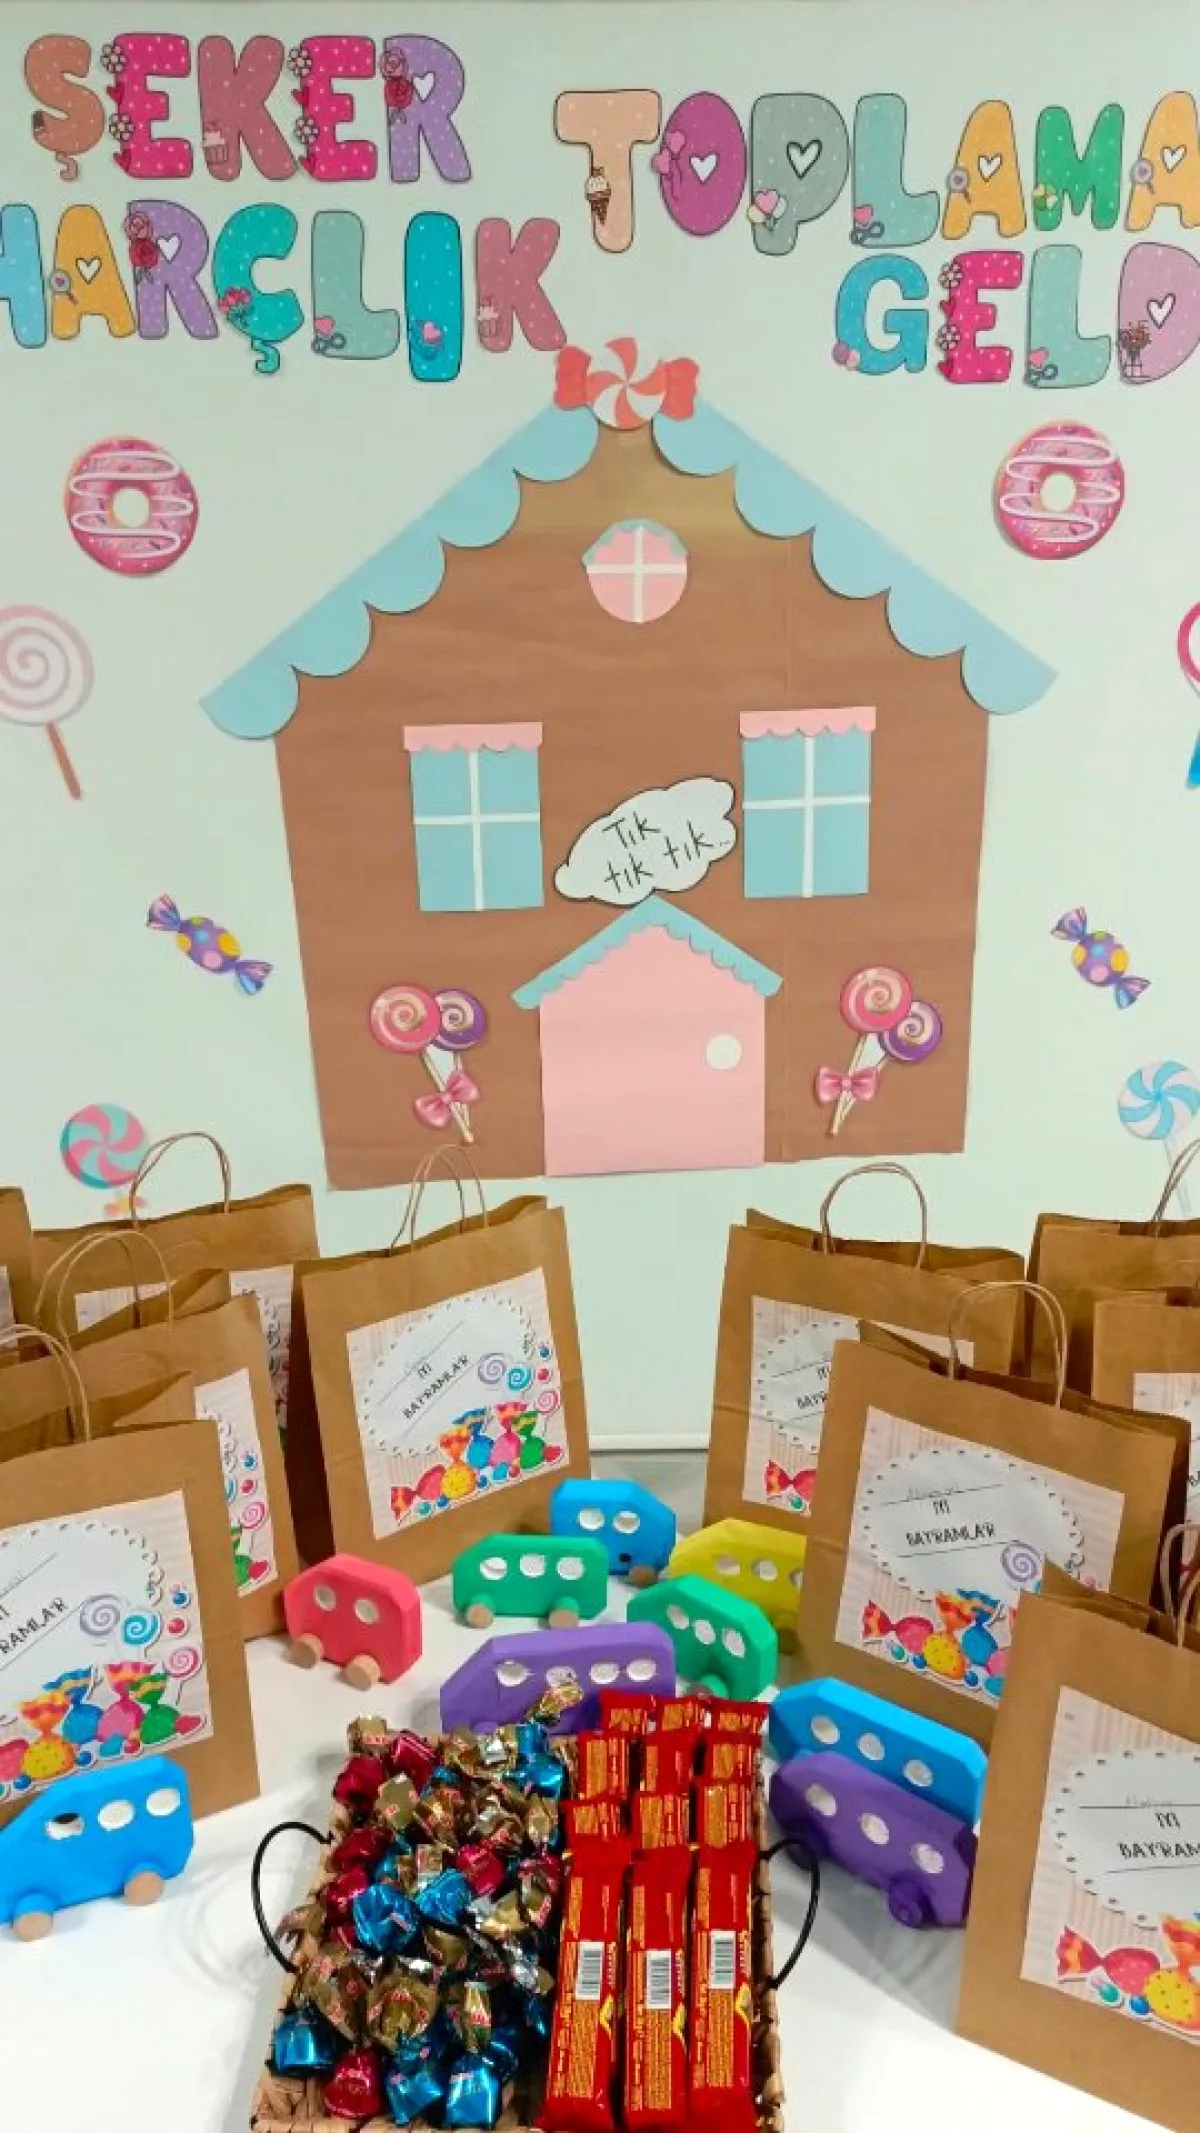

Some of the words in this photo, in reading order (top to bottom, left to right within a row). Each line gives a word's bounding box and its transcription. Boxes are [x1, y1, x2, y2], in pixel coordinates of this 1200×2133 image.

[24, 33, 471, 183] ŞEKER
[554, 88, 1200, 255] TOPLAMA
[832, 241, 1200, 388] GELD
